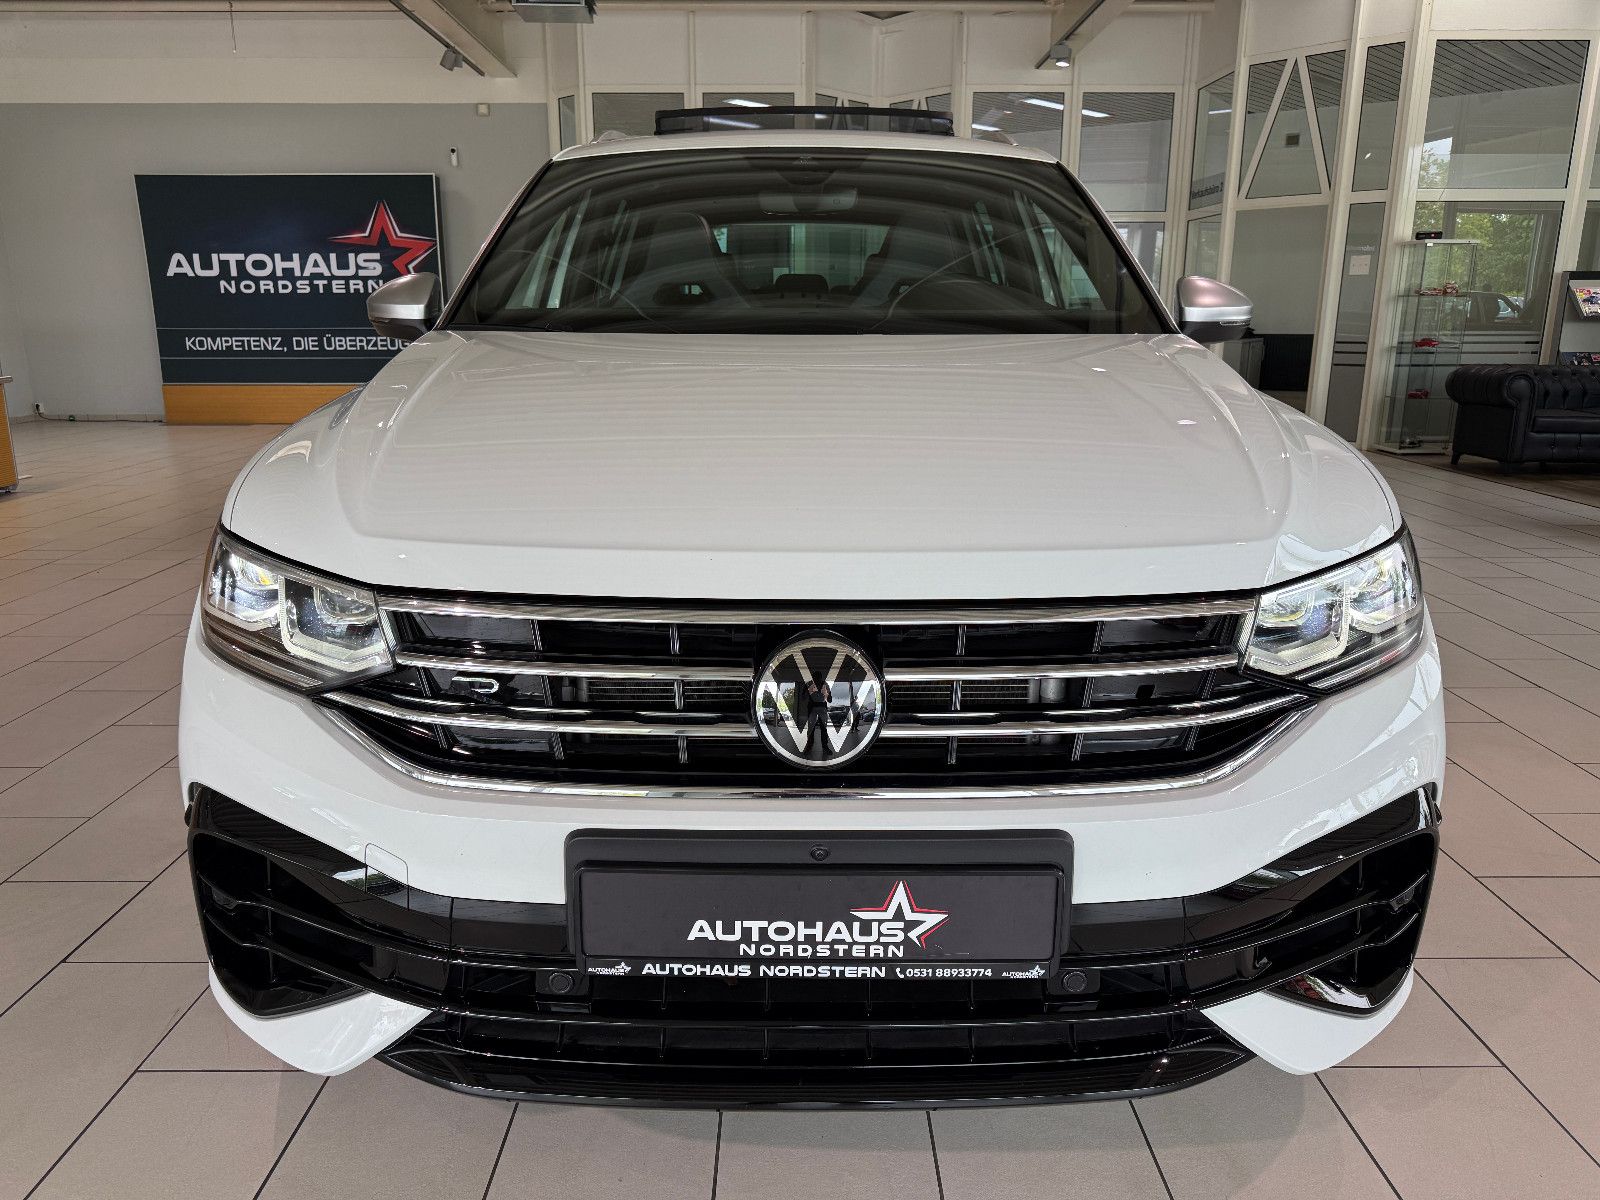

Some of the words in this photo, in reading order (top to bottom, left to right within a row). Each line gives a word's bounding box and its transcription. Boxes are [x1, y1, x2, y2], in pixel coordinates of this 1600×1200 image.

[166, 252, 383, 277] AUTOHAUS
[219, 279, 384, 295] NORDSTERN
[185, 336, 288, 353] KOMPETENZ,
[292, 336, 320, 351] DIE
[686, 919, 904, 943] AUTOHAUS
[739, 943, 904, 958] NORDSTERN
[641, 963, 752, 977] AUTOHAUS
[759, 964, 886, 978] NORDSTERN
[905, 968, 933, 977] 0531
[935, 968, 993, 977] 88933774
